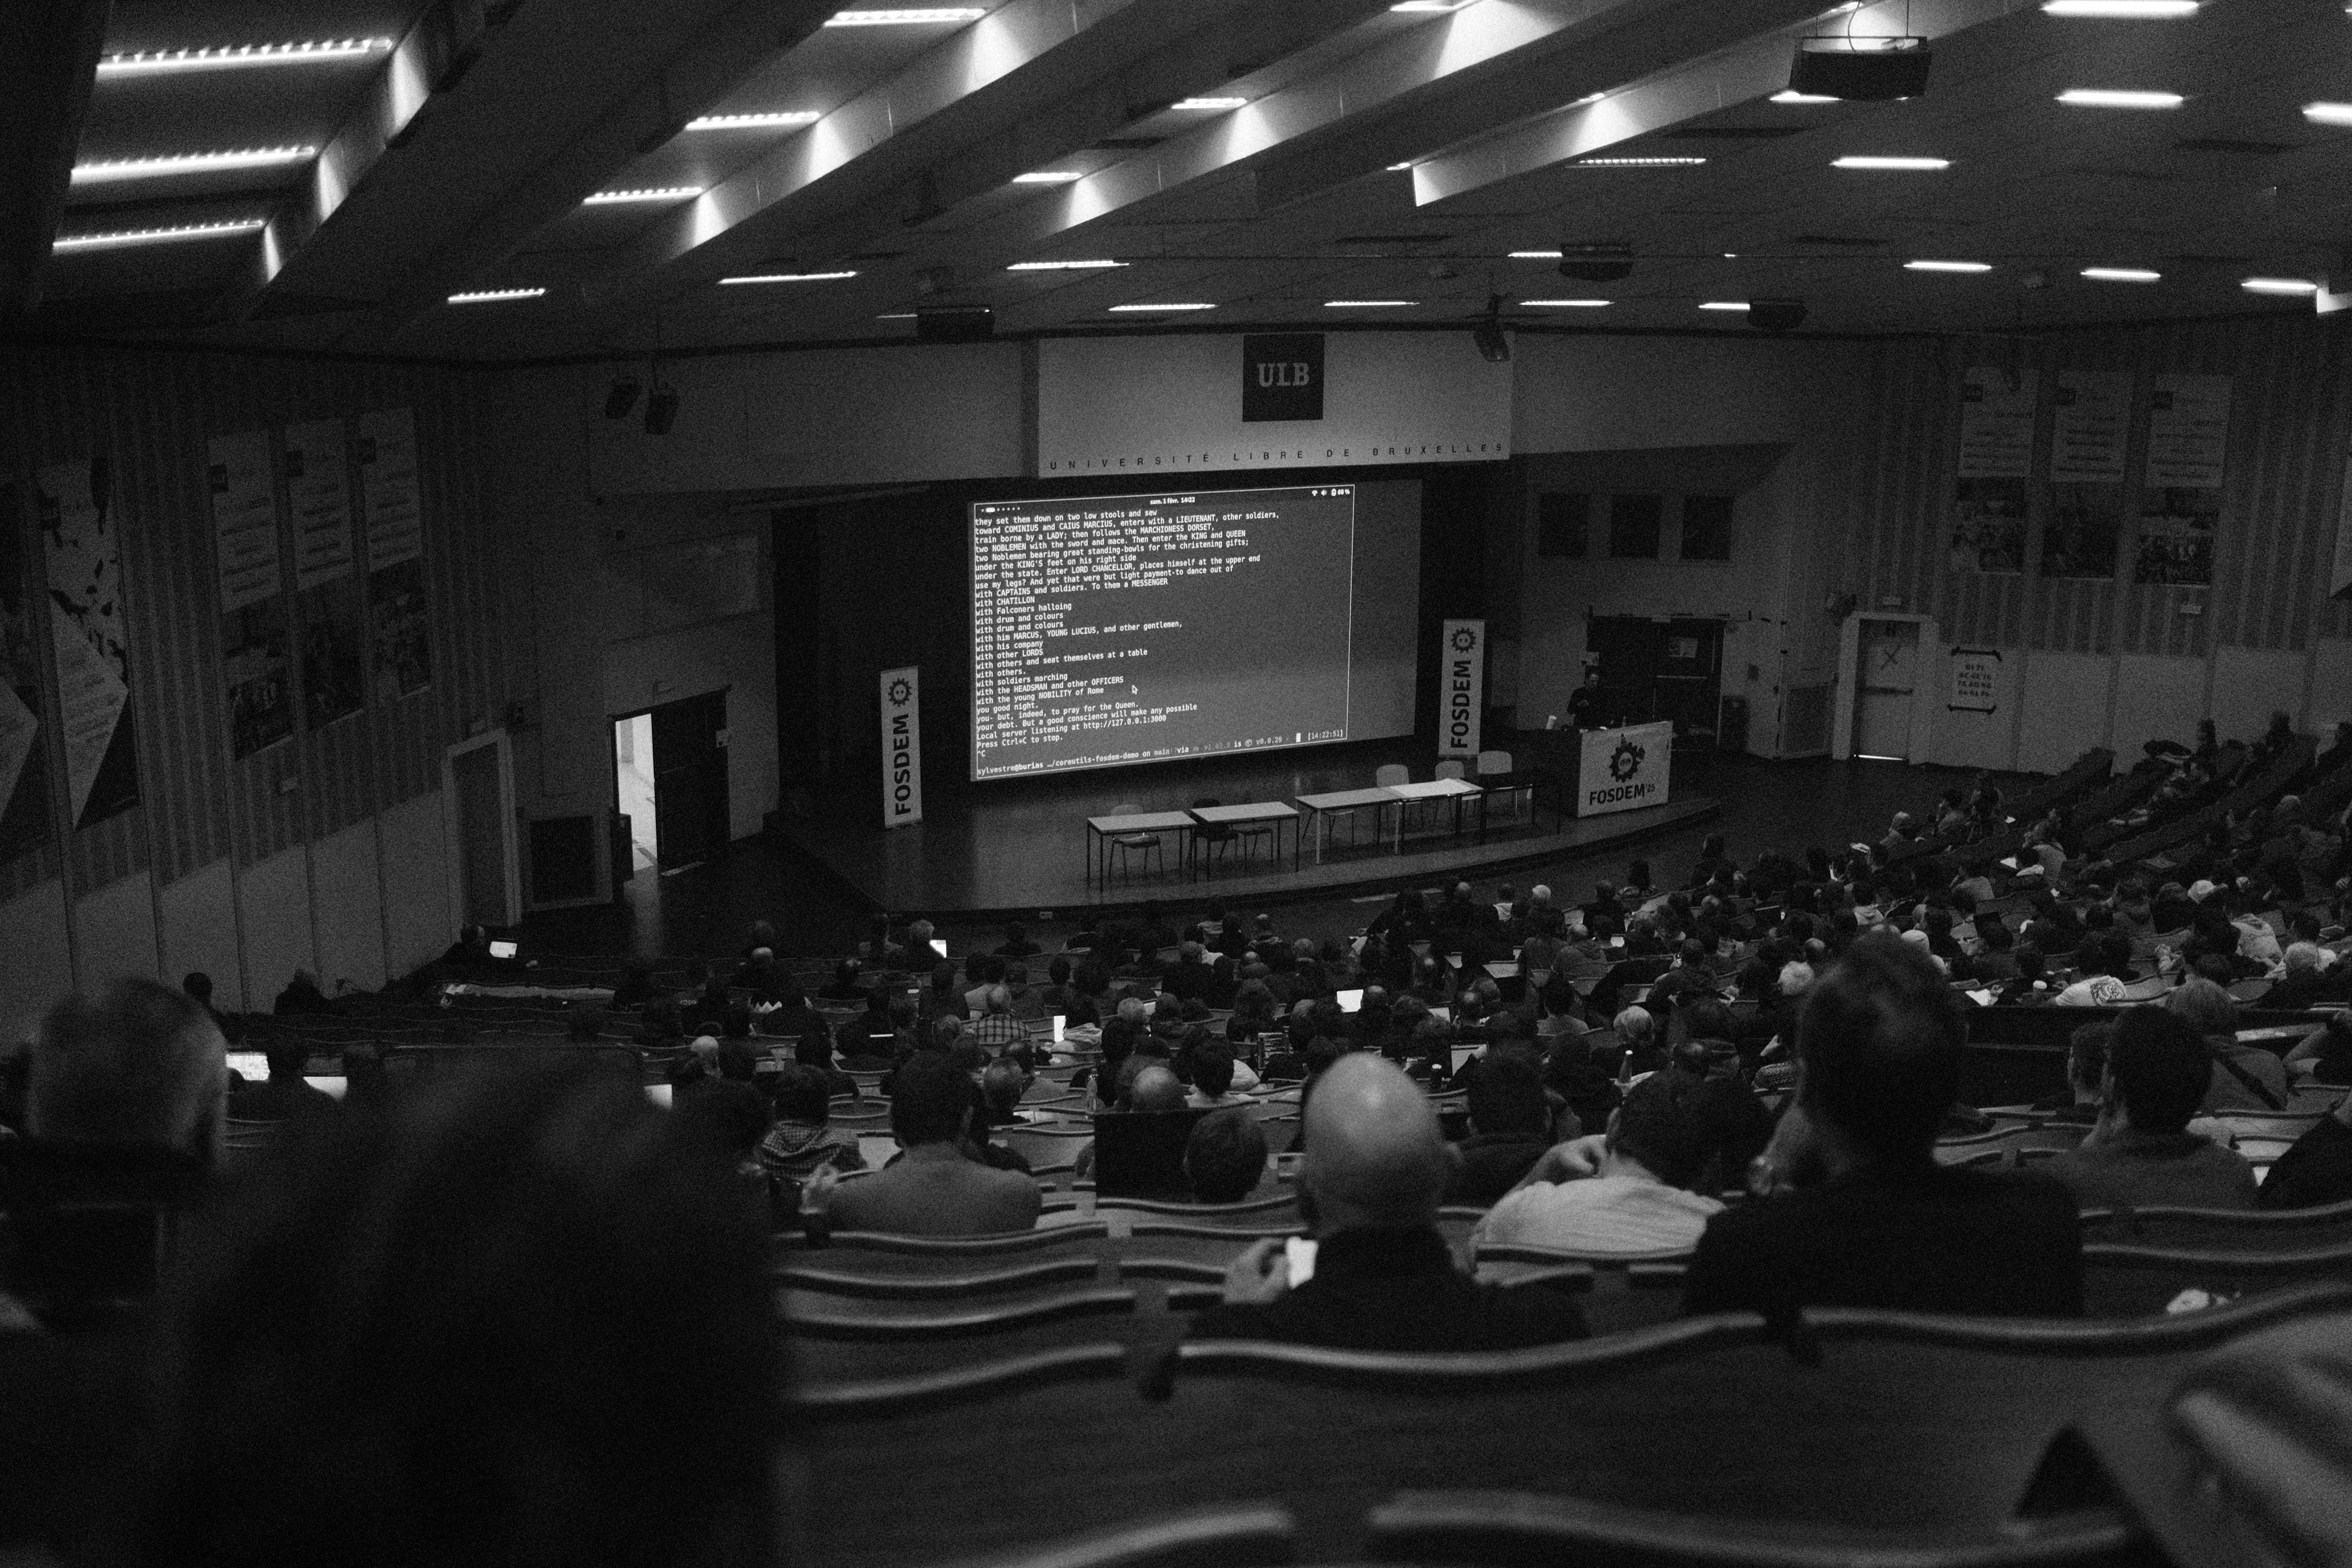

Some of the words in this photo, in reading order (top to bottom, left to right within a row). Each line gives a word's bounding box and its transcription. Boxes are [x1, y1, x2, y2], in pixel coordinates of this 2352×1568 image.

[1257, 363, 1309, 387] ULB
[1050, 452, 1209, 470] UNIVERSITÉ
[1233, 450, 1303, 461] LIBRE
[1326, 449, 1349, 457] DE
[1373, 444, 1501, 456] BRUXELLES
[975, 526, 1000, 534] toward
[1005, 524, 1038, 533] COMINIUS
[1084, 520, 1115, 528] MARCIUS,
[1176, 514, 1218, 523] LIEUTENANT,
[1026, 533, 1034, 542] by
[1140, 525, 1184, 534] MARCHIONESS
[992, 543, 1026, 551] NOBLEMEN
[1030, 550, 1059, 558] bearing
[1063, 548, 1084, 557] great
[1088, 545, 1144, 554] standing-bowls
[1180, 540, 1222, 549] christening
[1226, 539, 1248, 547] gifts;
[1092, 563, 1135, 572] CHANCELLOR,
[1140, 562, 1164, 570] places
[1168, 559, 1195, 567] himself
[1005, 579, 1026, 588] legs?
[1047, 577, 1059, 585] yet
[1120, 571, 1140, 580] light
[1144, 569, 1183, 579] payment-to
[997, 596, 1034, 605] CHATILLON
[1039, 603, 1071, 611] halloing
[1014, 631, 1042, 640] MARCUS,
[1072, 626, 1099, 635] LUCIUS,
[1143, 621, 1182, 631] gentlemen,
[1063, 653, 1104, 662] themselves
[1014, 683, 1047, 692] HEADSMAN
[1092, 676, 1124, 685] OFFICERS
[993, 704, 1010, 713] good
[1014, 702, 1038, 710] night.
[1451, 660, 1471, 748] FOSDEM
[977, 724, 994, 732] your
[1047, 716, 1063, 725] good
[1067, 713, 1107, 722] conscience
[1166, 703, 1197, 714] possible
[977, 731, 997, 740] Local
[1031, 725, 1067, 734] listening
[1084, 714, 1166, 729] http://127.0.0.1:3000
[1002, 737, 1027, 746] Ctrl+C
[977, 762, 1043, 776] sylvestre@burias
[1308, 729, 1343, 741] [14:22:51]
[893, 714, 911, 815] FOSDEM
